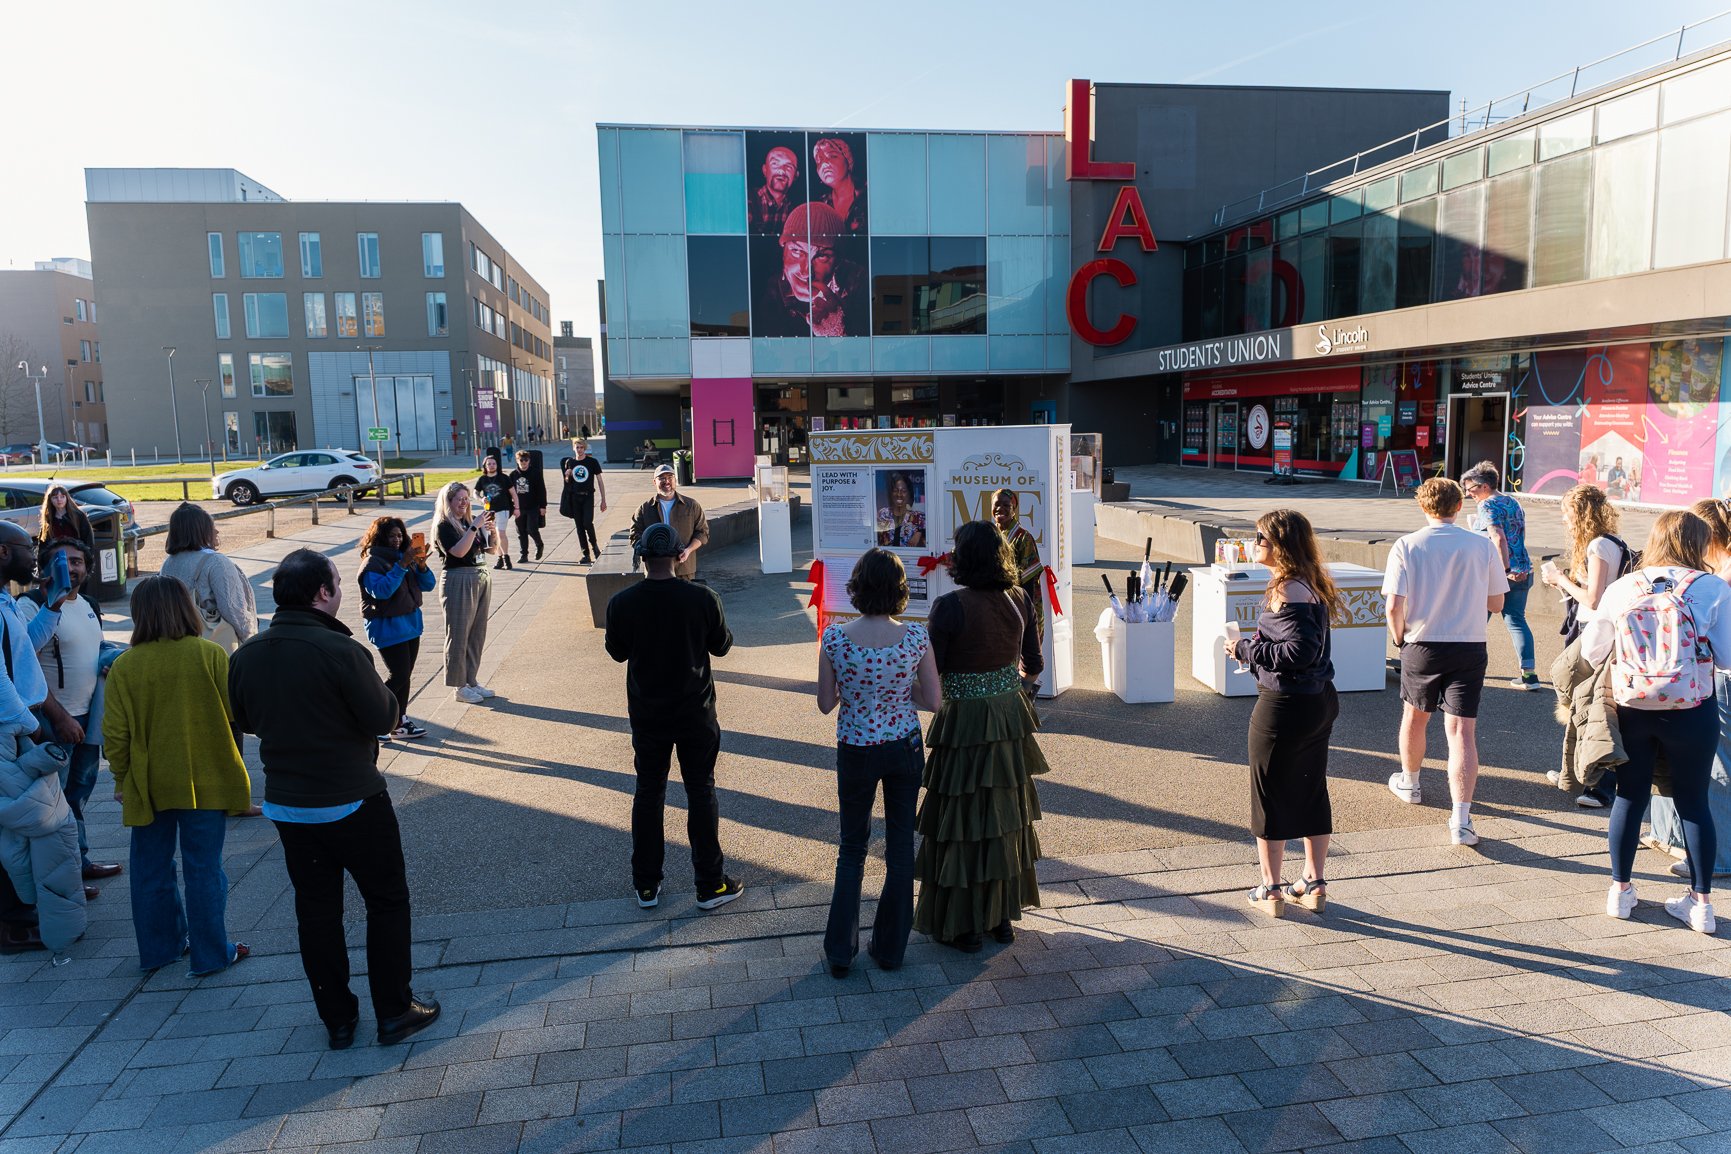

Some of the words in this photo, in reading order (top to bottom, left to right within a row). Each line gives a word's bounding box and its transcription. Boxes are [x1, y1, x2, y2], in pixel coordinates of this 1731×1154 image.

[1333, 325, 1369, 345] Lincoln
[1159, 341, 1224, 371] STUDENTS'
[1228, 334, 1280, 363] UNION
[479, 401, 495, 409] TIME
[952, 475, 1011, 485] MUSEUM
[1017, 476, 1036, 486] OF
[822, 485, 836, 493] JOY.
[946, 490, 1043, 544] ME
